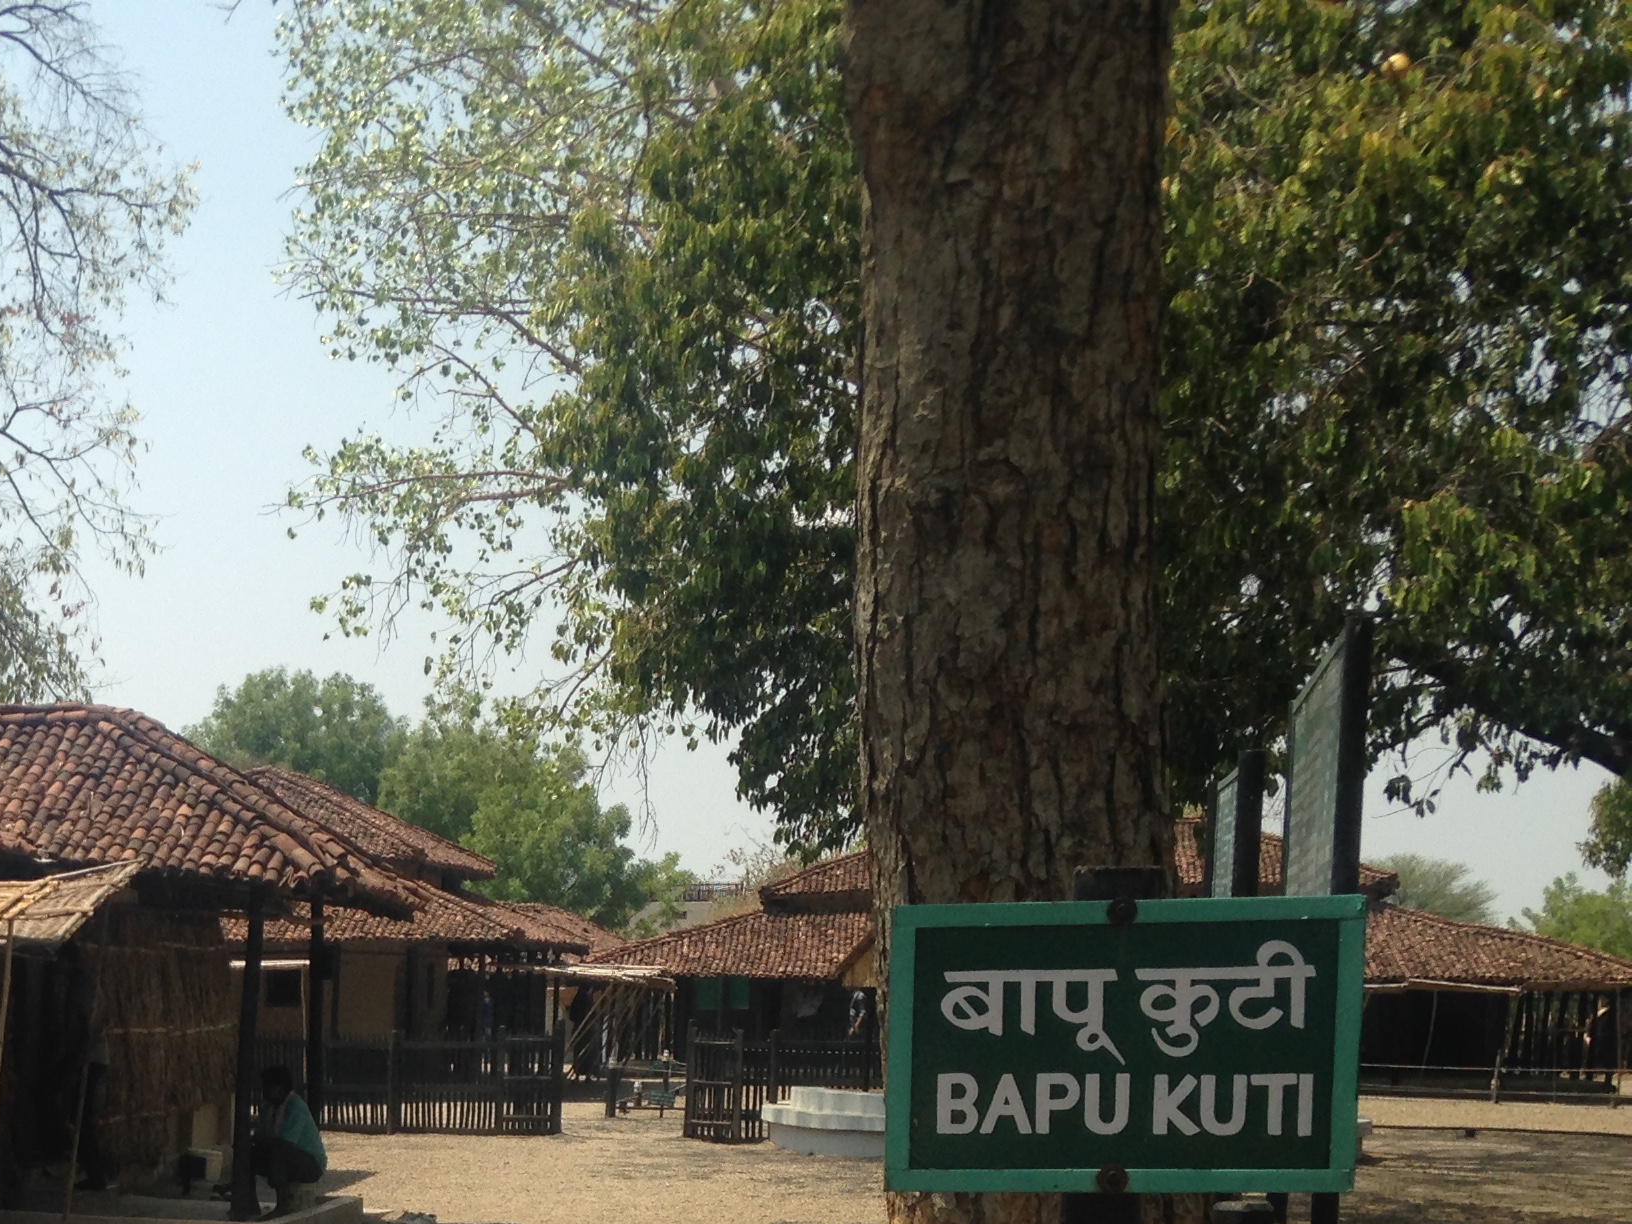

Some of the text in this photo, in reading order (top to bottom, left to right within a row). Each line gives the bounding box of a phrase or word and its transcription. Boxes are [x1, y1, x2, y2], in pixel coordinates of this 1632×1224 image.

[940, 939, 1316, 1065] बापू कुटी
[936, 1072, 1314, 1137] BAPU KUTI
